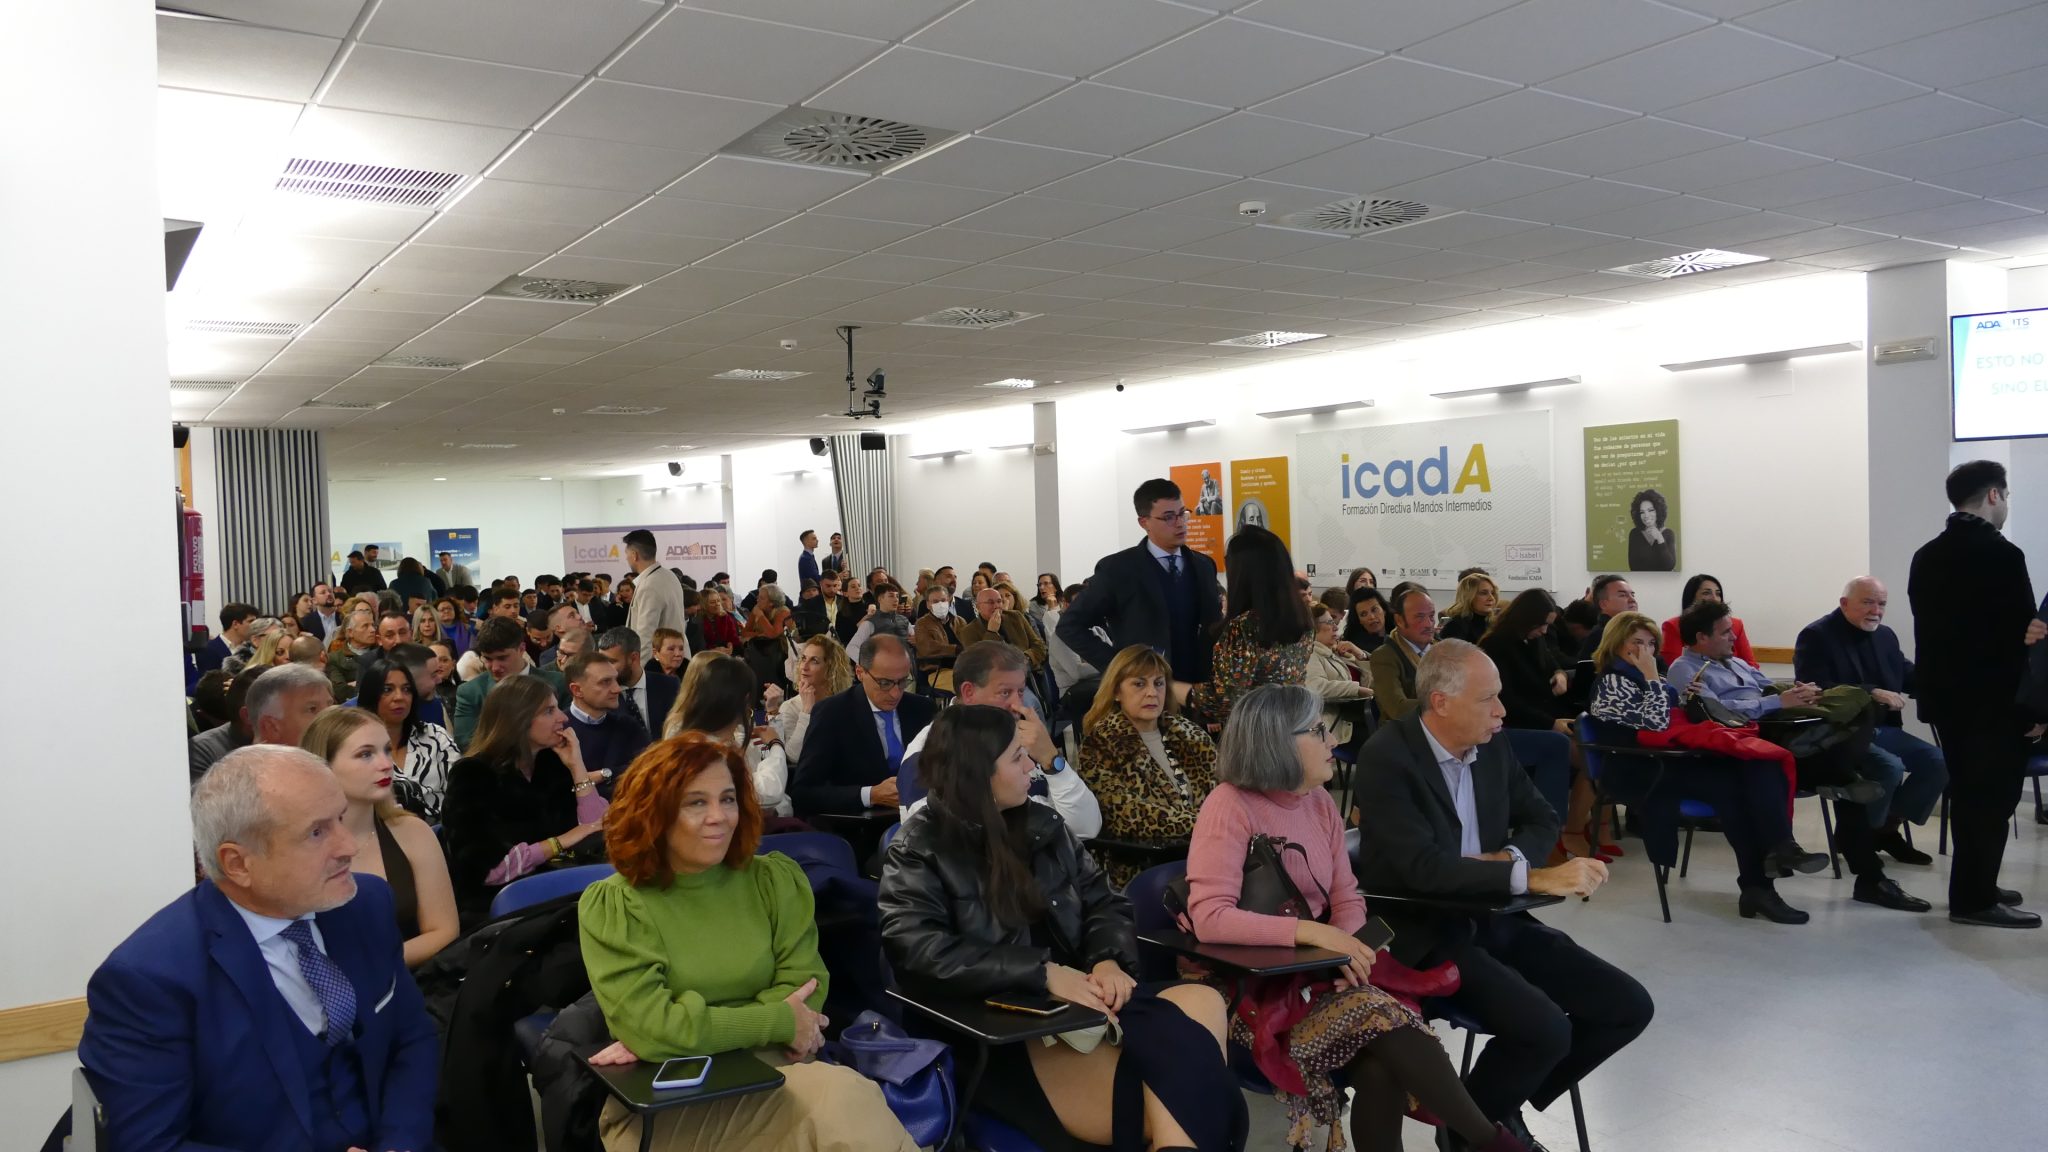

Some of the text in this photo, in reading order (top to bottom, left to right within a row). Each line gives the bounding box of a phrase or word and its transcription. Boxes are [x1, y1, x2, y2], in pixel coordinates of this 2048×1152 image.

[1976, 320, 2001, 330] ADA
[1976, 352, 2044, 369] ESTO NO
[1991, 380, 2028, 395] SINO
[1341, 443, 1492, 499] icadA
[1342, 498, 1493, 516] Formación Directiva Mandos Intermedios
[1519, 551, 1538, 559] Isabel
